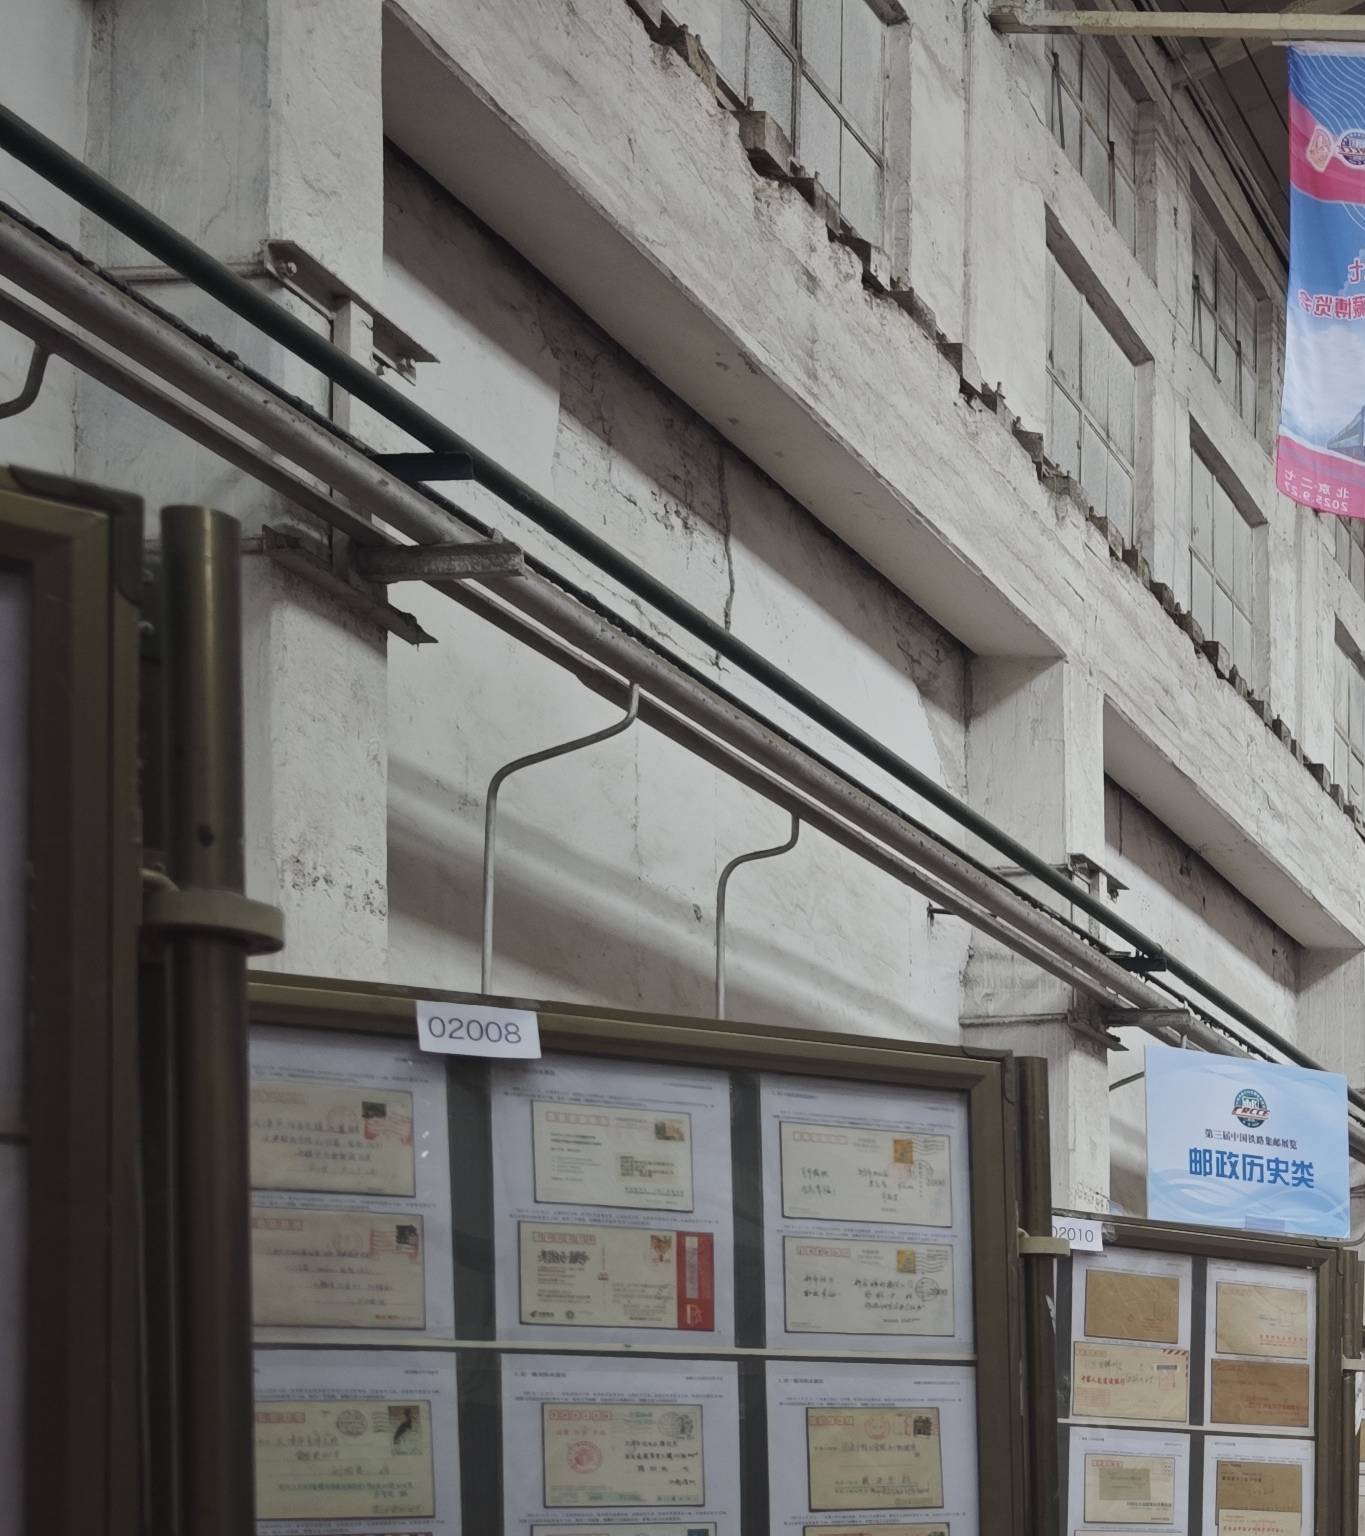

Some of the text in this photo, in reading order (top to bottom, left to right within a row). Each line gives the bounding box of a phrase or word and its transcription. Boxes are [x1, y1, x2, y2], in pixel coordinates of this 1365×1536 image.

[429, 1016, 521, 1043] 02008
[1205, 1128, 1298, 1150] 第三届中国铁路集邮展览
[1189, 1147, 1315, 1189] 邮政历史类
